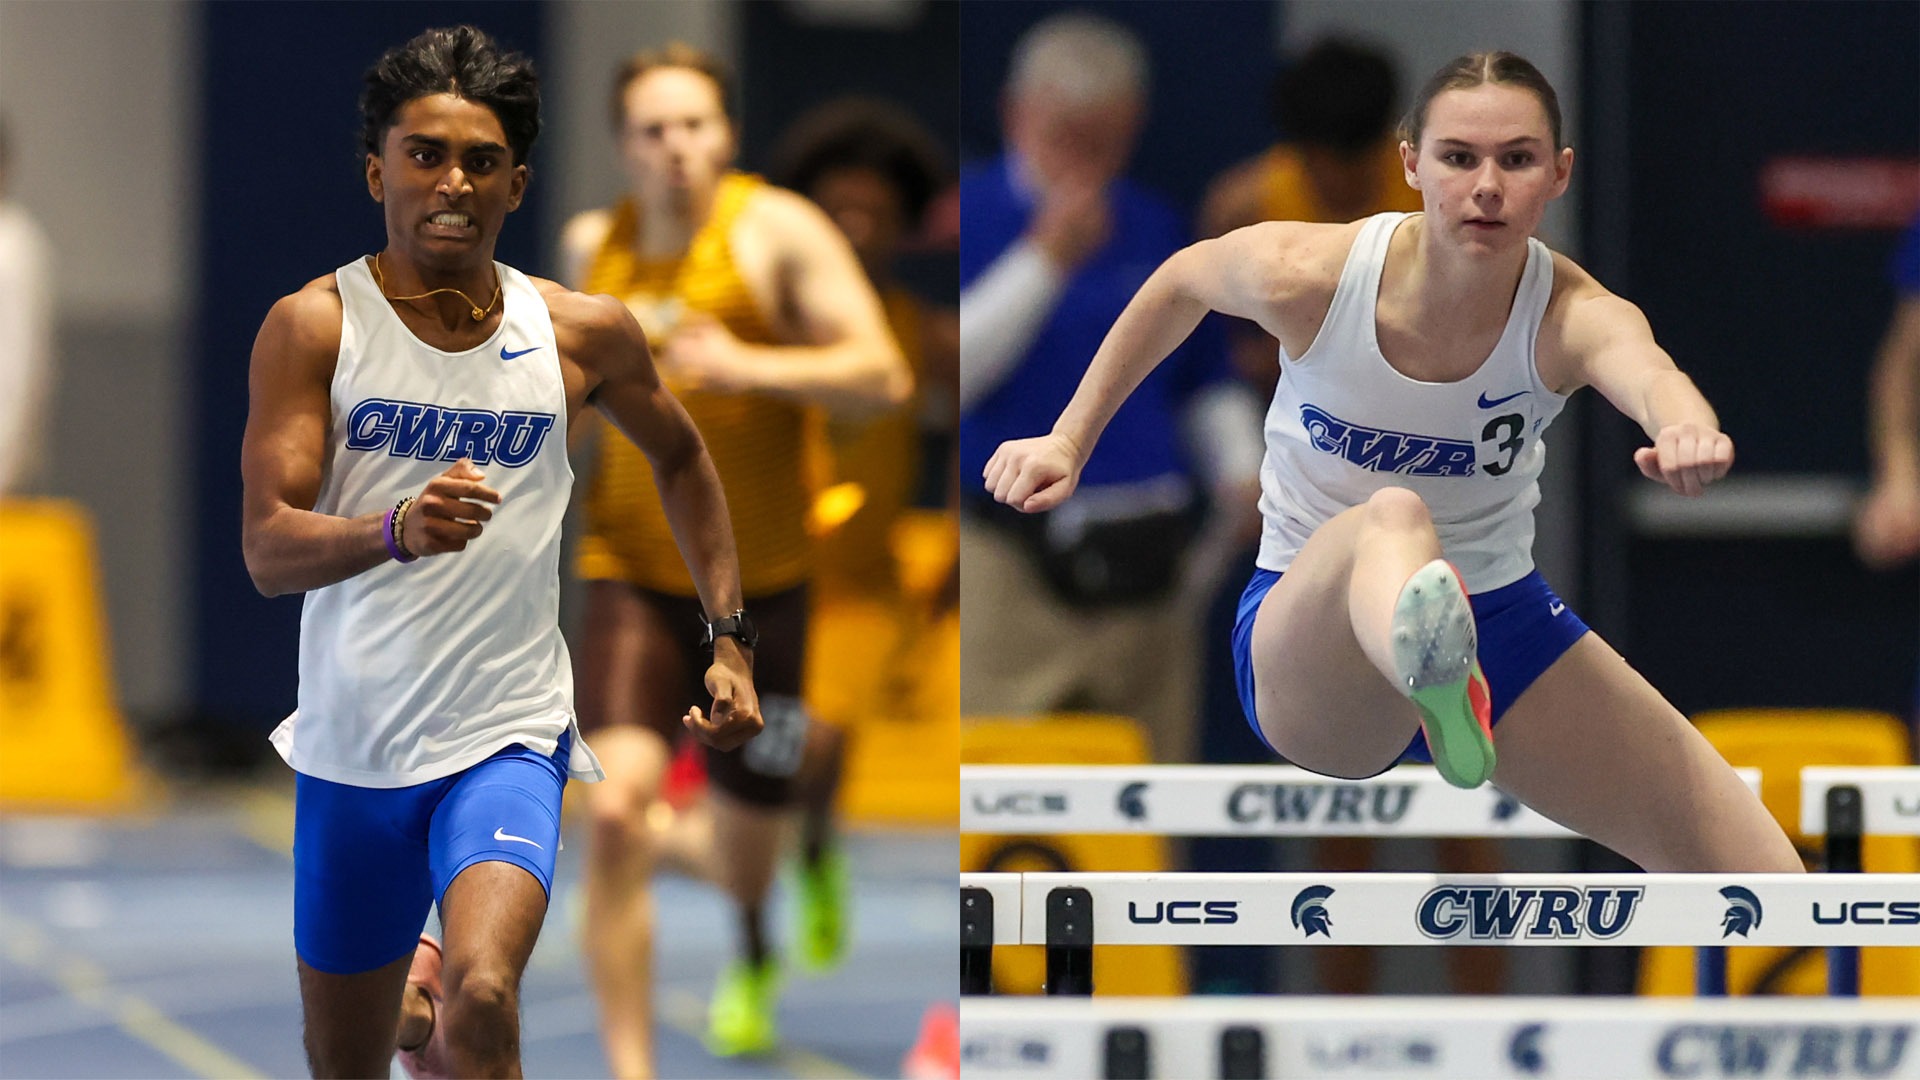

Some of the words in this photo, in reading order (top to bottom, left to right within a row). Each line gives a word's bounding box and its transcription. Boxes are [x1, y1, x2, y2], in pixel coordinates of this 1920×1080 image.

[345, 397, 557, 469] CWRU
[1299, 402, 1476, 478] CWR
[1481, 413, 1524, 476] 3
[1226, 783, 1419, 824] CWRU
[1128, 901, 1238, 924] UCS
[1415, 884, 1646, 940] CWRU
[1812, 902, 1920, 925] UCS
